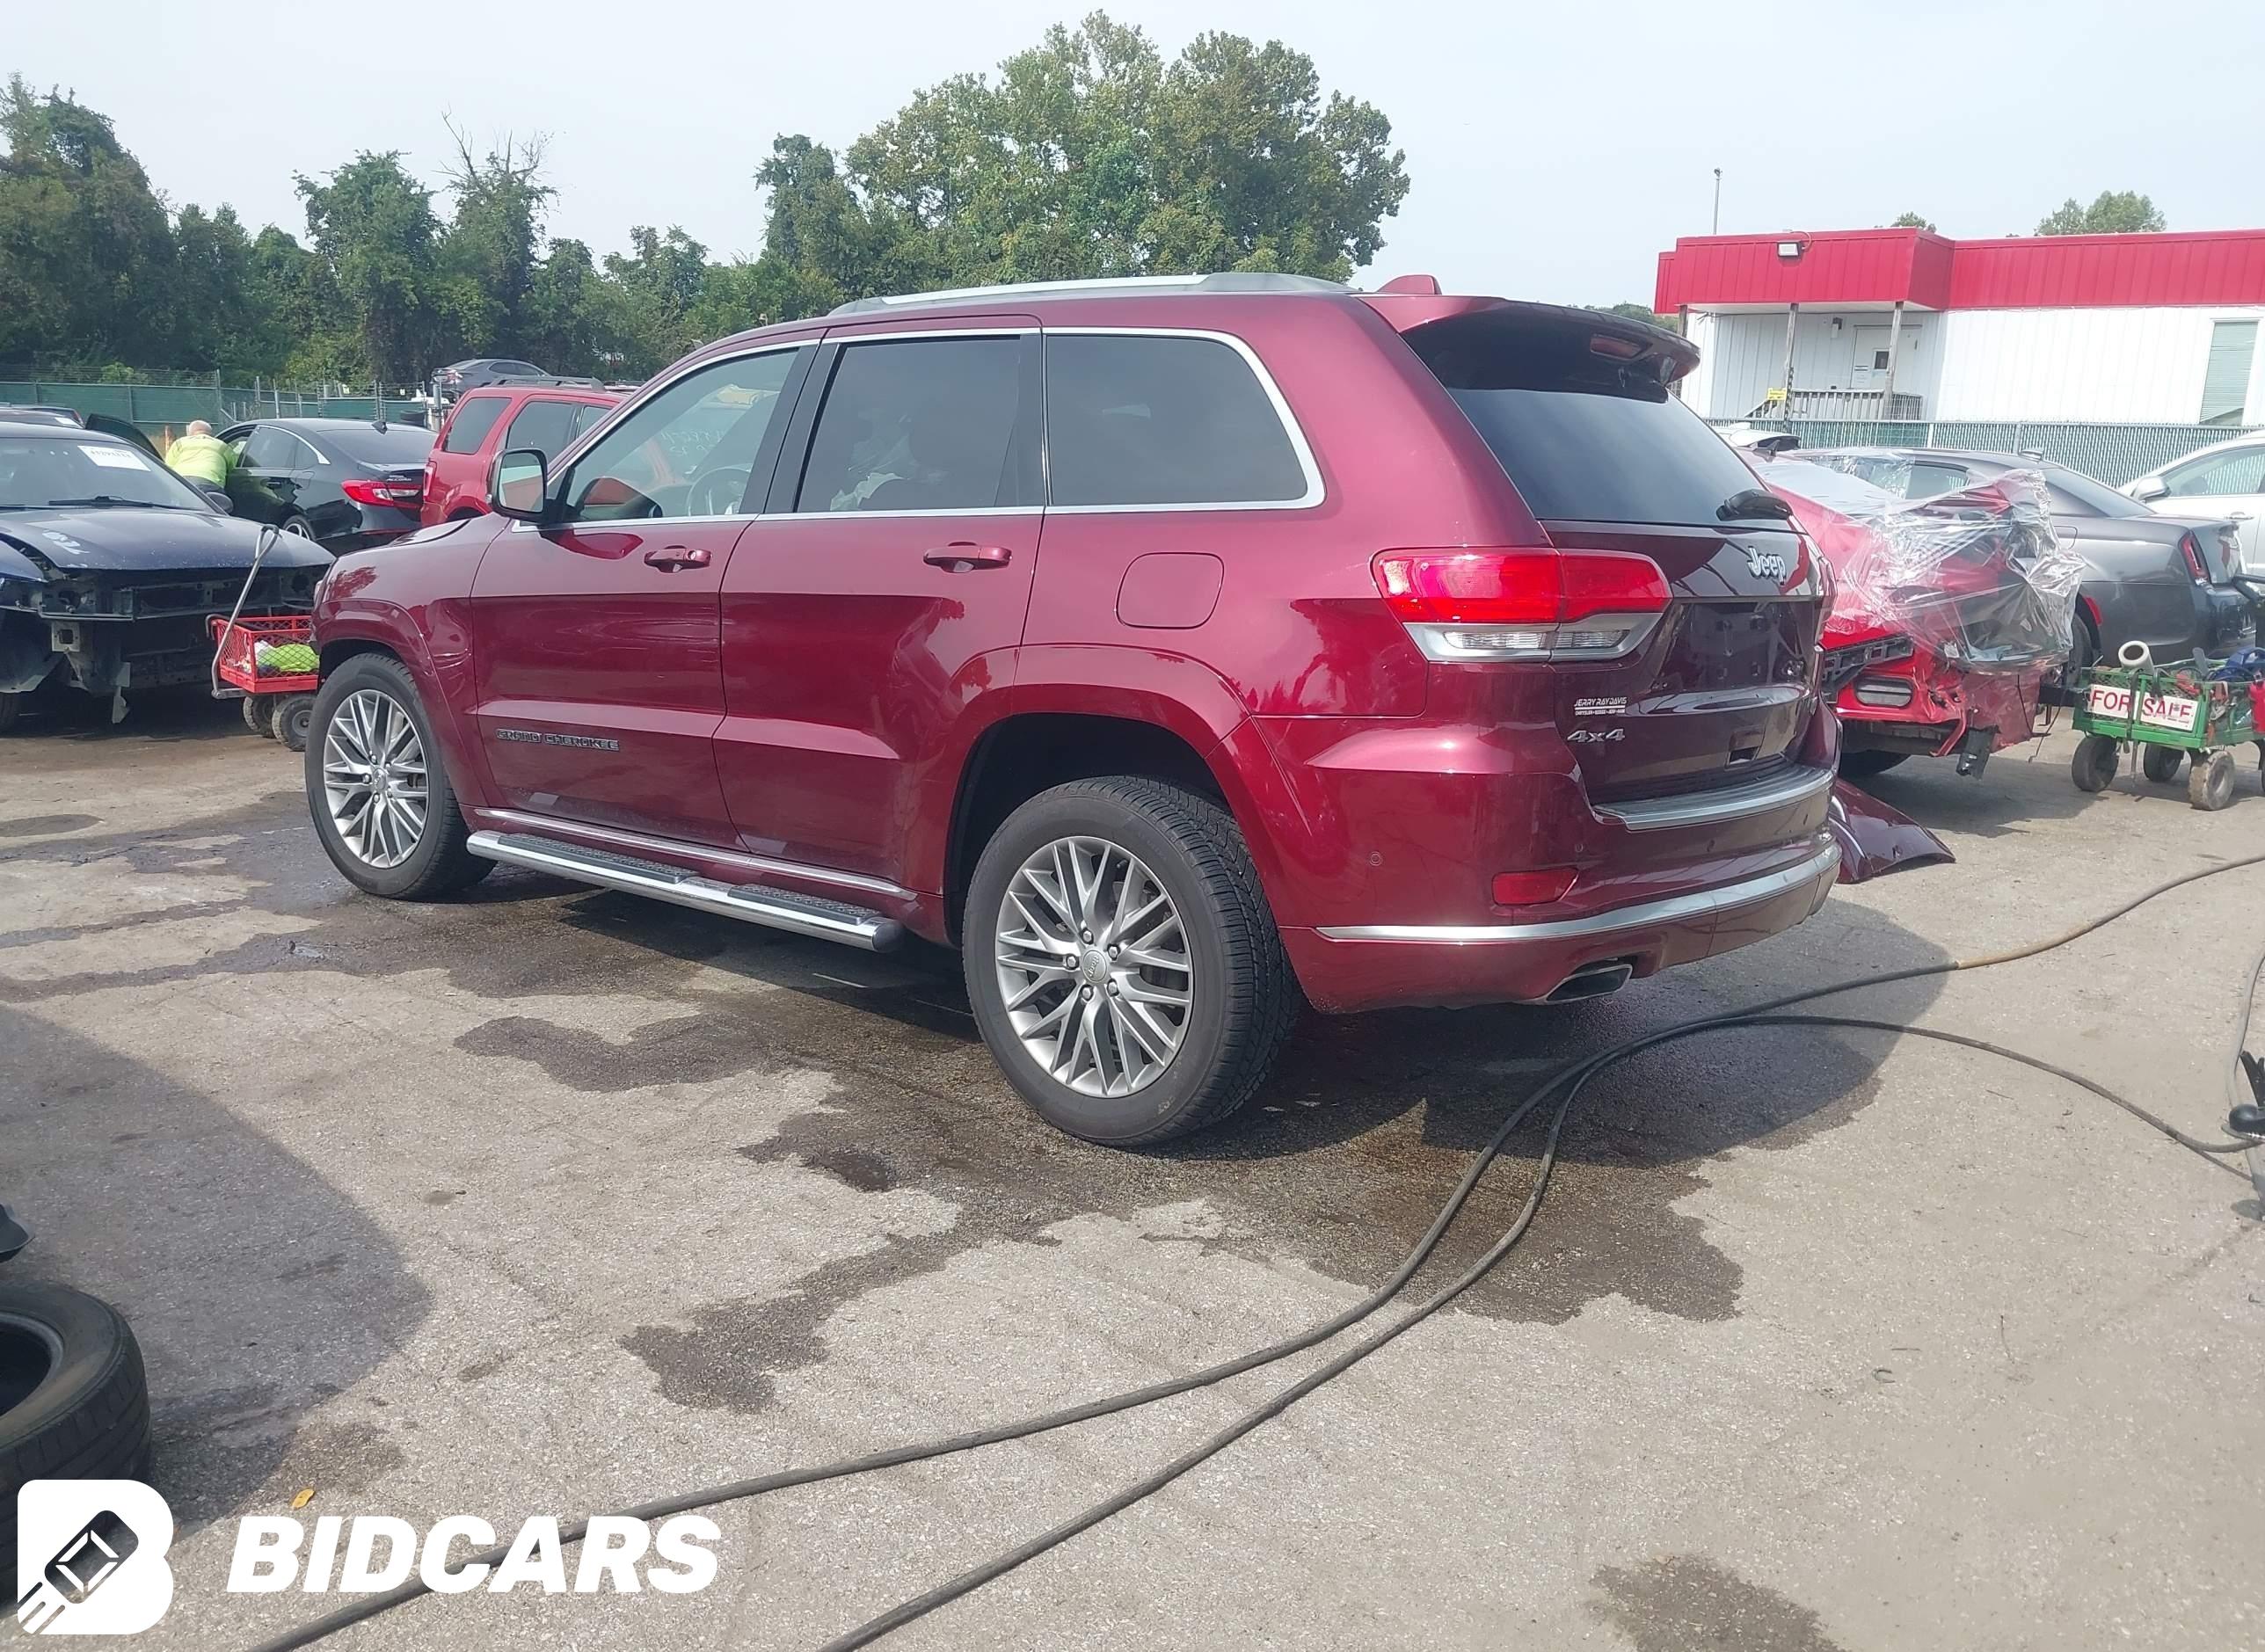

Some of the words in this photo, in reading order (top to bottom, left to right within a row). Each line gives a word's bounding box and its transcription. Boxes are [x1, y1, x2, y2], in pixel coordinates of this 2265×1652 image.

[1747, 547, 1786, 584] Jeep
[1596, 697, 1609, 706] RAY
[1609, 696, 1628, 705] DAVIS
[2091, 689, 2131, 712] FOR
[496, 729, 542, 743] GRAND
[544, 733, 620, 752] CHEROKEE
[1567, 728, 1626, 743] 4x4
